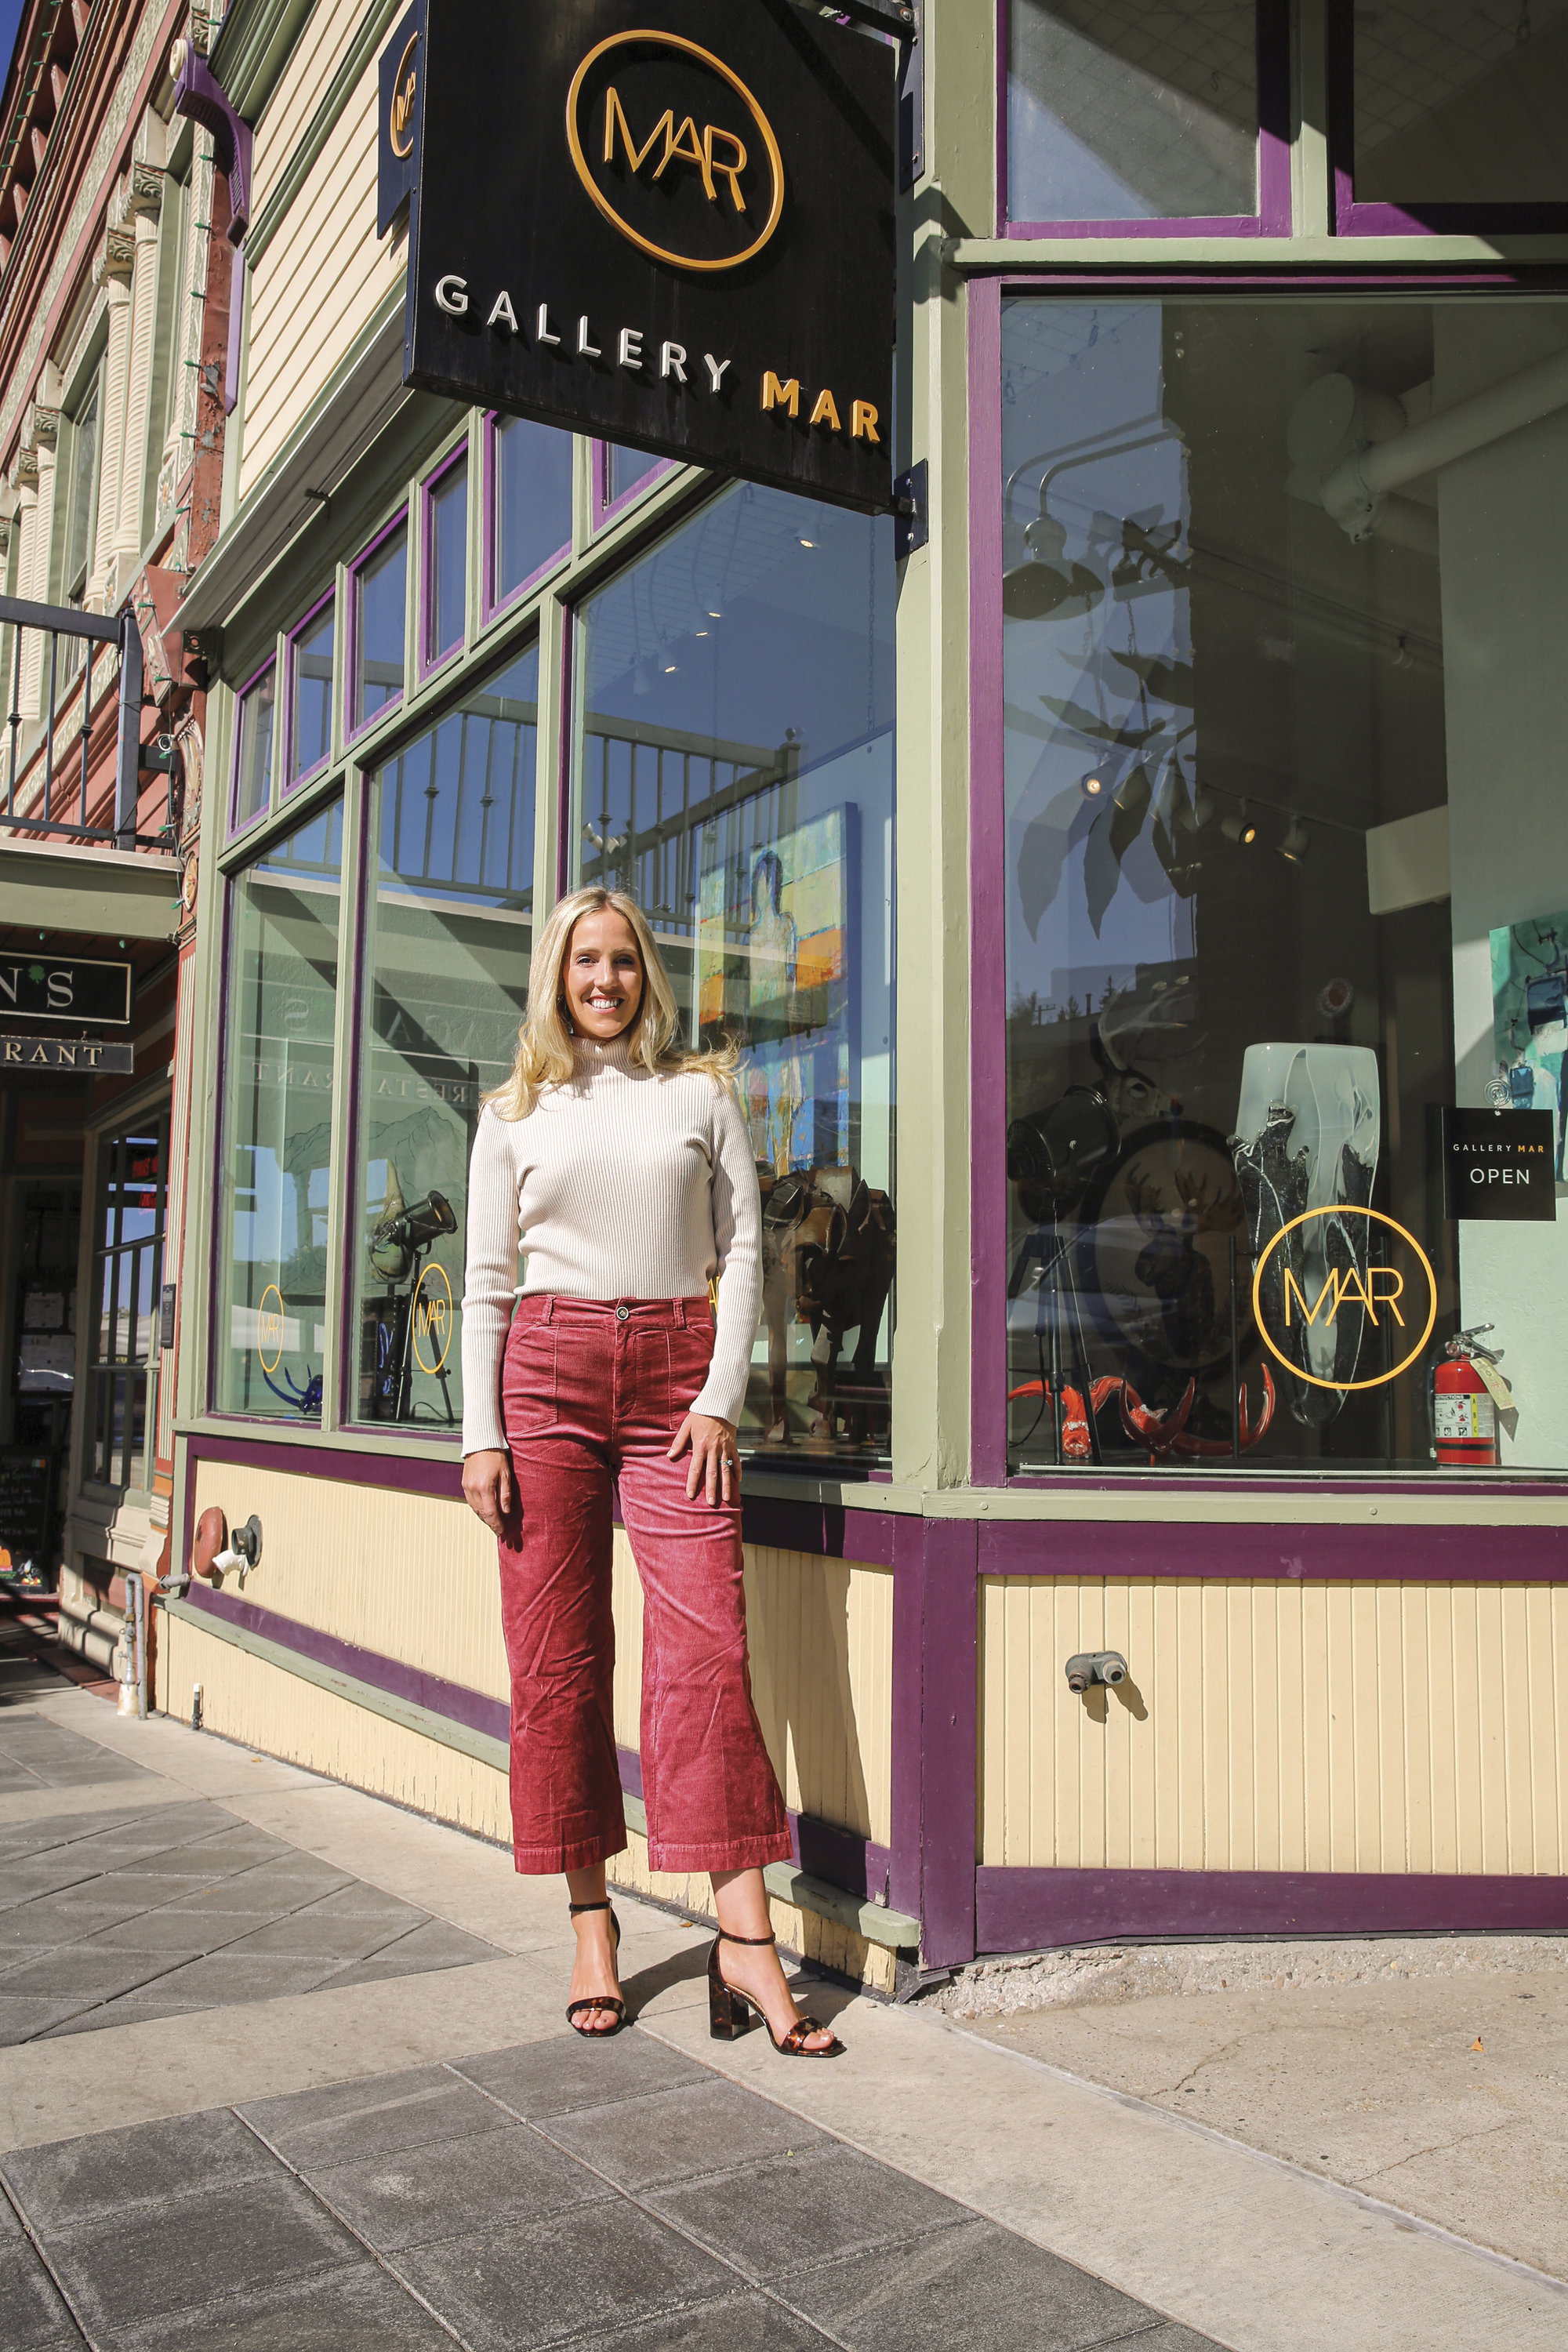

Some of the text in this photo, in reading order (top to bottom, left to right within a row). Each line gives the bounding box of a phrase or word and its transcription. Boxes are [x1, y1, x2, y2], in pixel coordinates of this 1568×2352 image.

[604, 86, 747, 212] MAR
[434, 274, 880, 444] GALLERY MAR
[4, 1042, 103, 1068] RANT
[1470, 1168, 1530, 1185] OPEN
[1283, 1267, 1406, 1327] MAR
[262, 1313, 279, 1343] MAR
[418, 1299, 445, 1337] MAR
